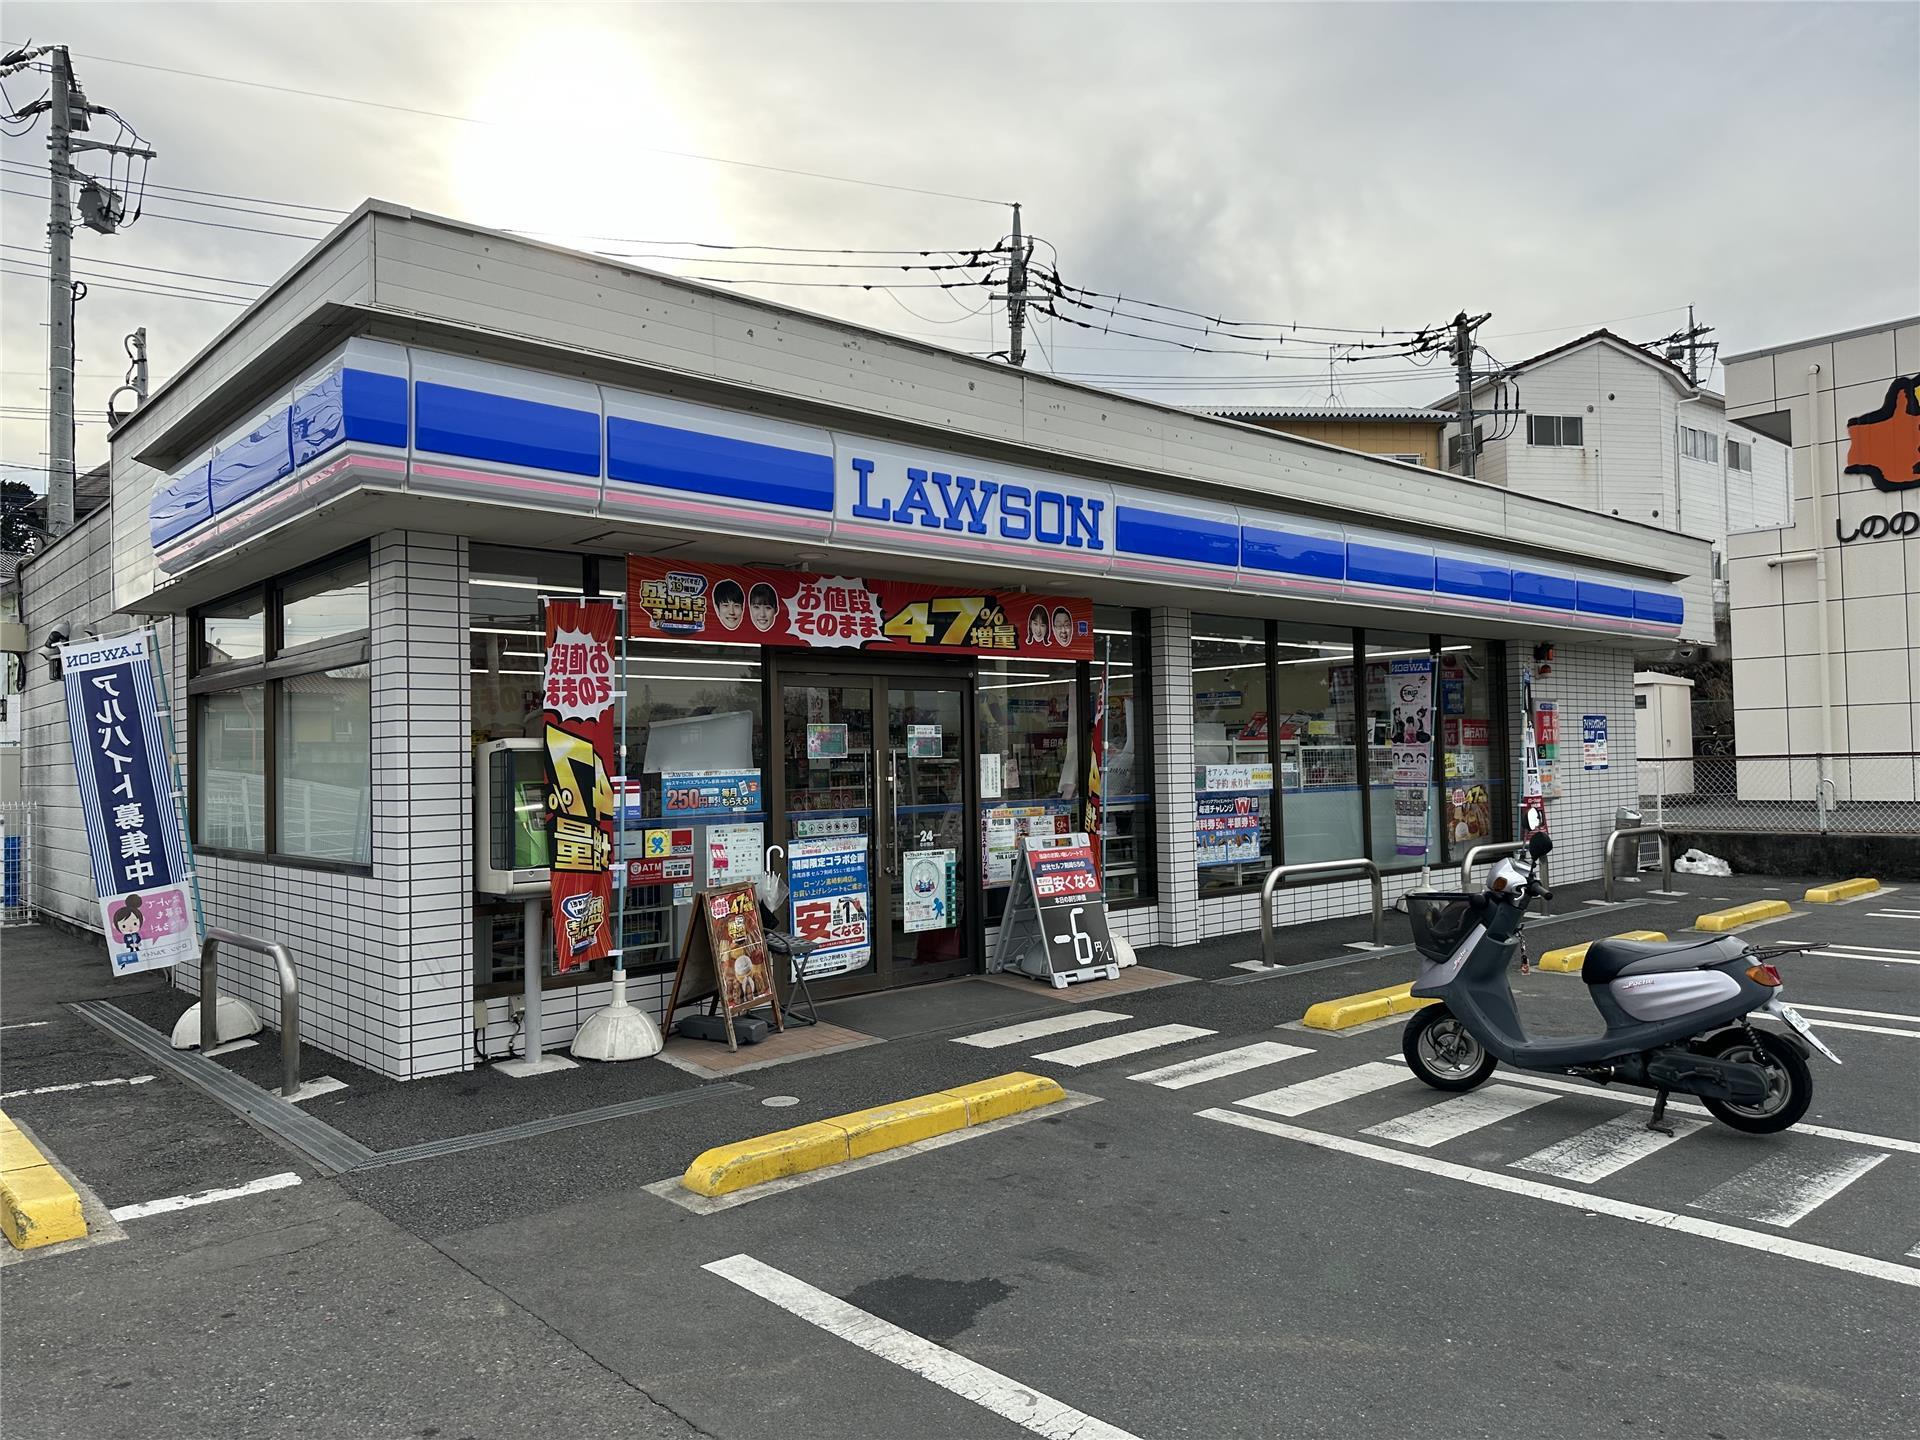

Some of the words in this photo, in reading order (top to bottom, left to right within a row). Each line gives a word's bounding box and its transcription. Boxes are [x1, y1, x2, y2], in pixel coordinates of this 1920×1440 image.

[852, 457, 1104, 550] LAWSON
[799, 584, 872, 614] お値段
[652, 608, 705, 622] チャレンジ
[795, 612, 880, 639] そのまま
[970, 624, 1017, 648] 増量
[1043, 738, 1067, 748] 無印良
[919, 830, 934, 842] 24
[642, 863, 662, 872] ATM
[1053, 873, 1096, 892] 安くなる
[796, 902, 831, 941] 安
